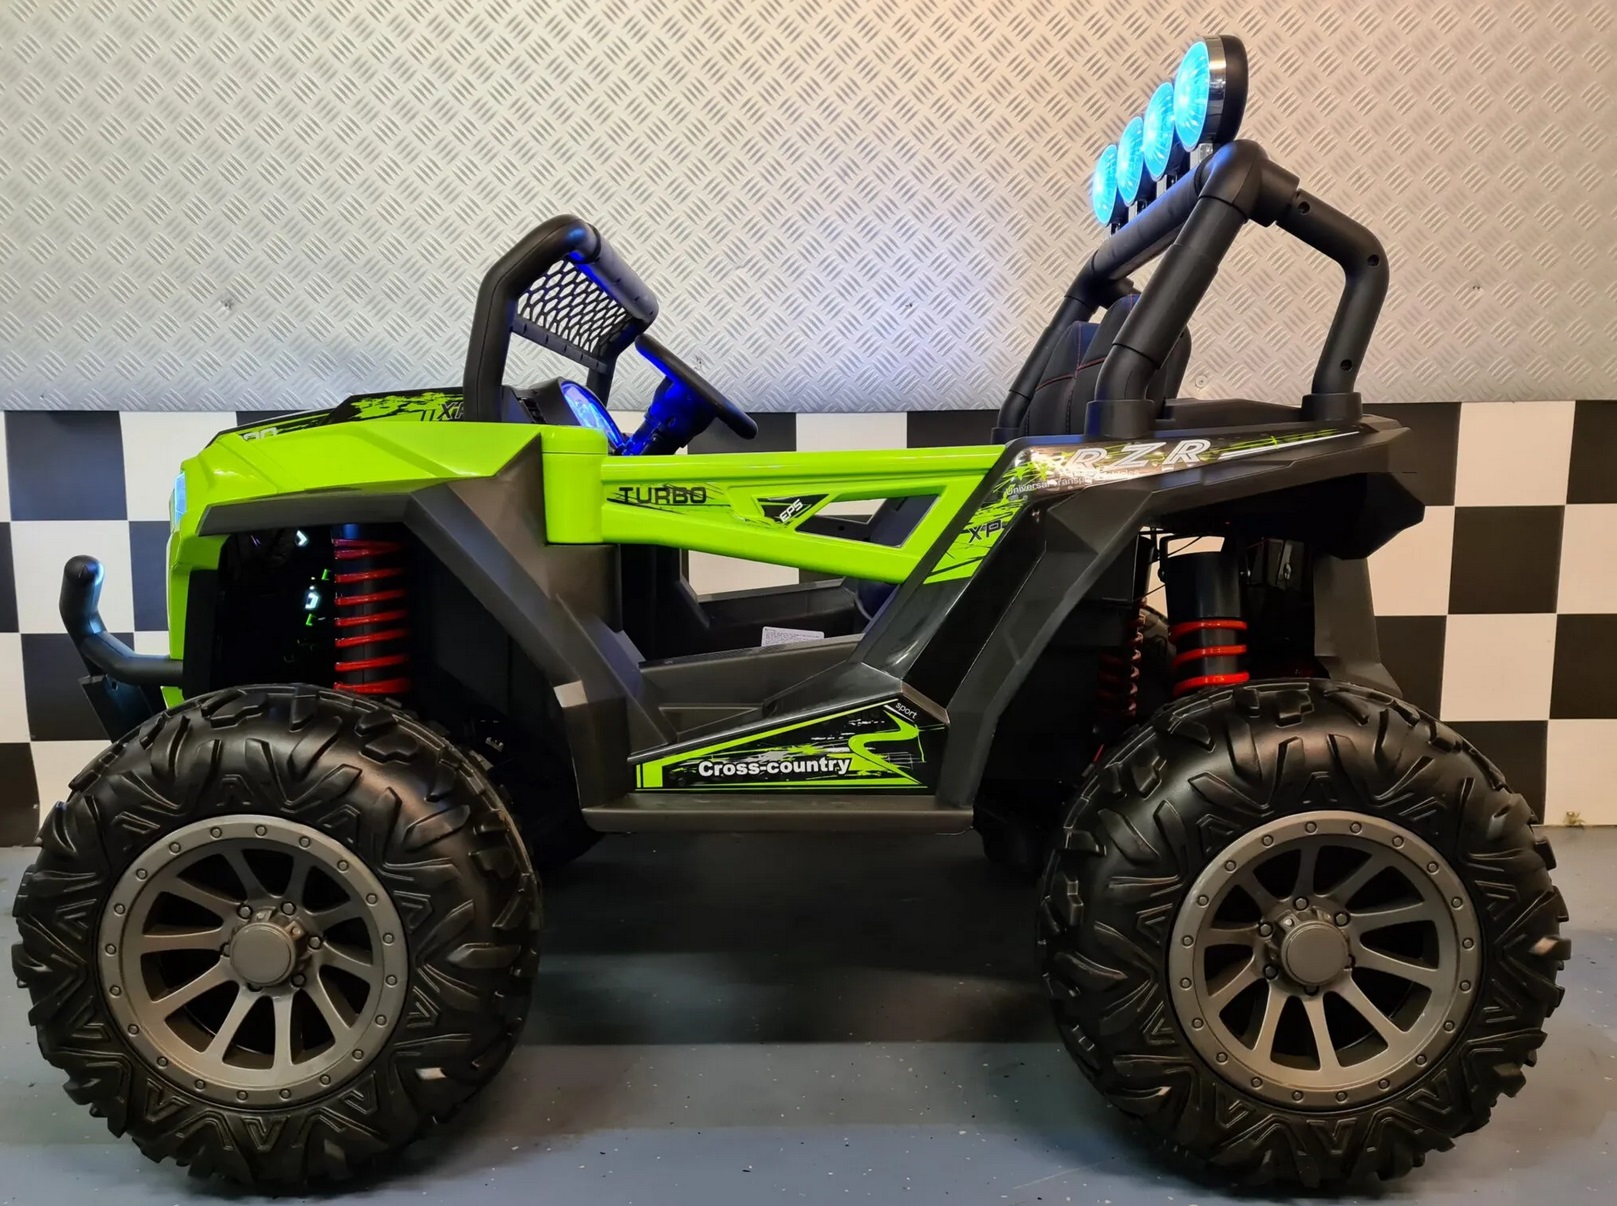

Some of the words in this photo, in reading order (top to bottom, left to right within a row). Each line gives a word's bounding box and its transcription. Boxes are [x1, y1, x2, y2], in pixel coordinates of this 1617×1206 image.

[1064, 439, 1211, 470] RZR
[618, 486, 707, 505] TURBO
[779, 499, 804, 523] EPS
[895, 702, 918, 719] sport
[698, 756, 850, 779] Cross-country
